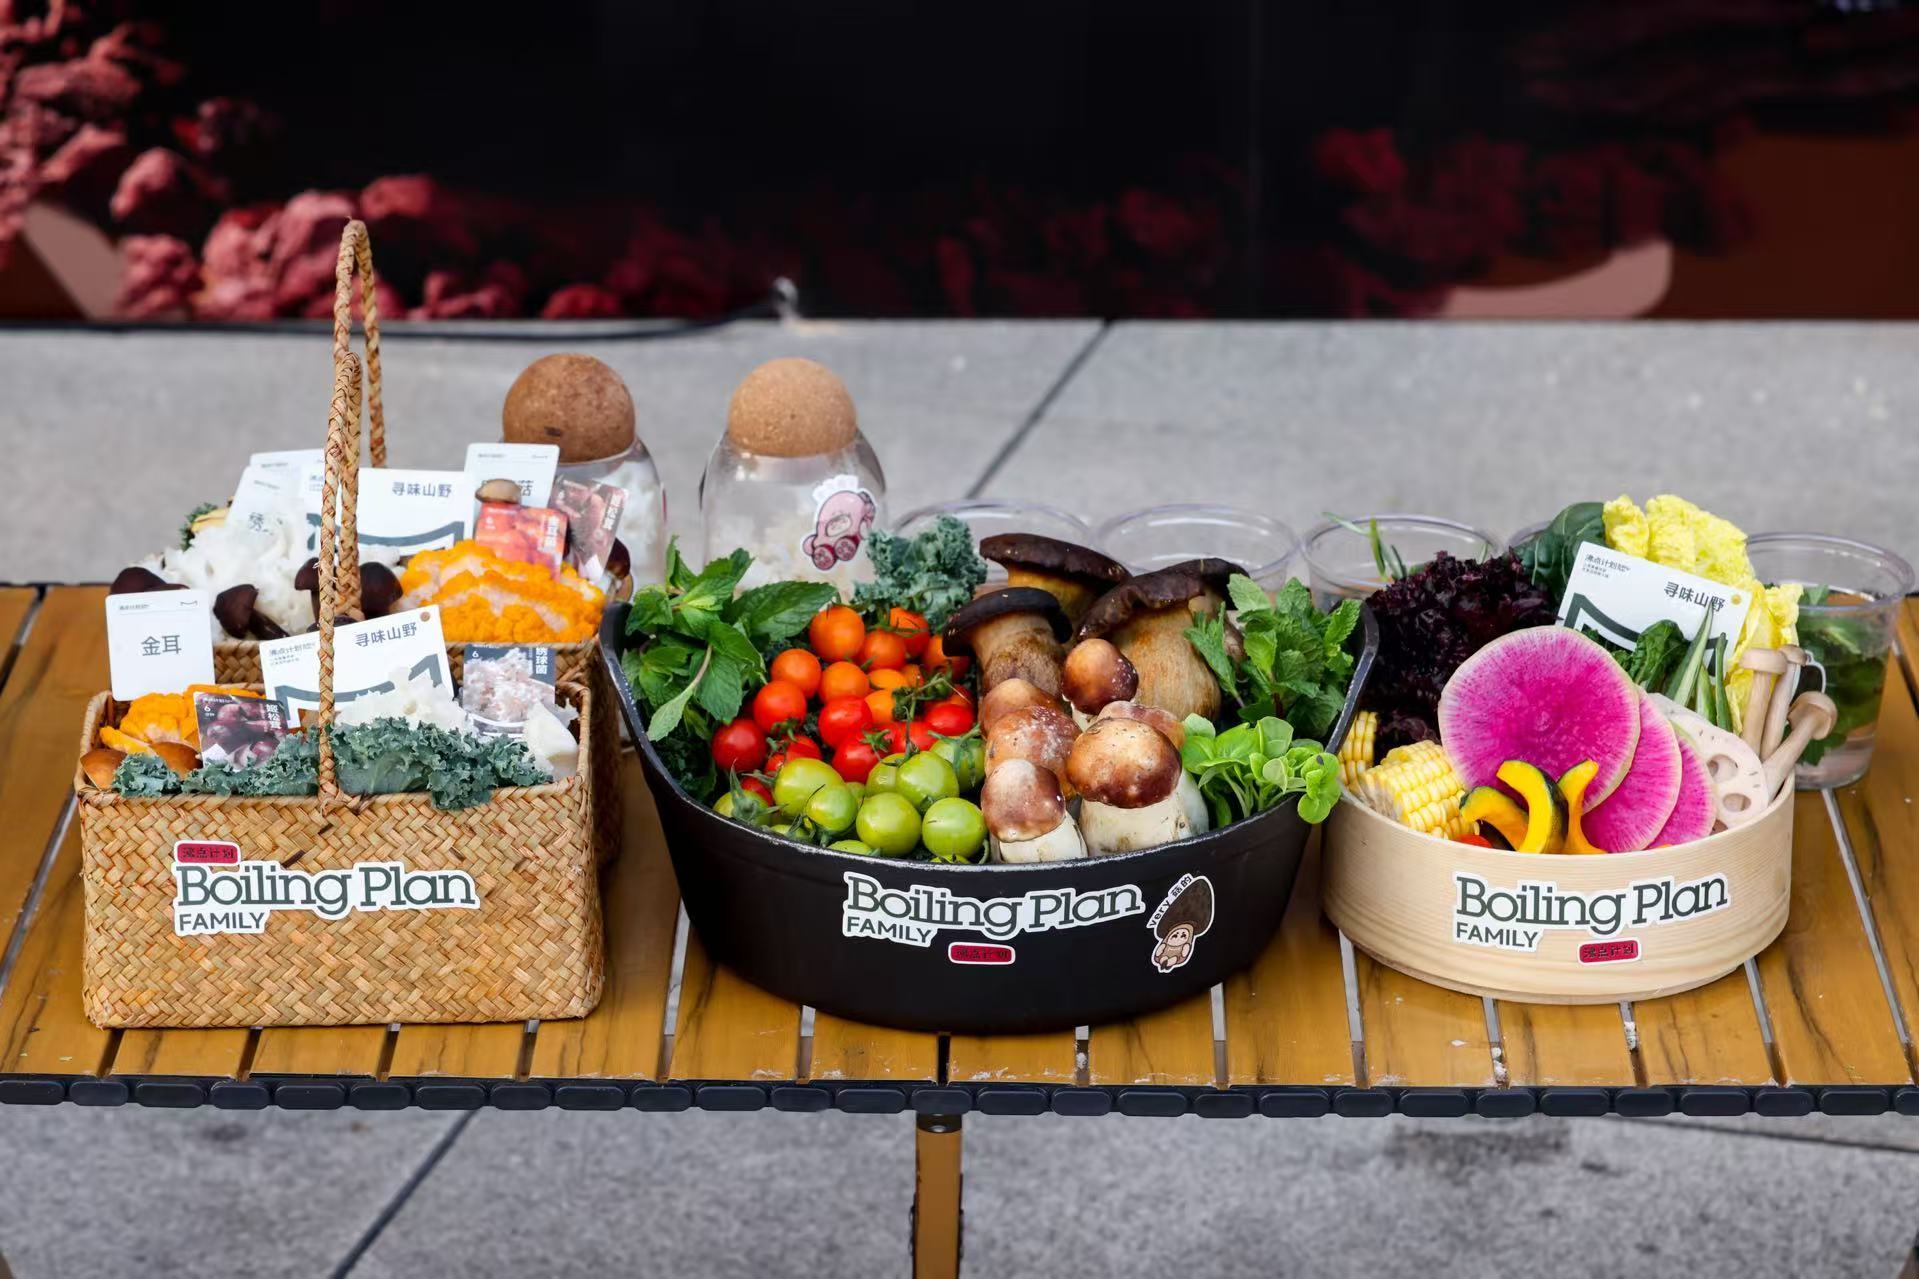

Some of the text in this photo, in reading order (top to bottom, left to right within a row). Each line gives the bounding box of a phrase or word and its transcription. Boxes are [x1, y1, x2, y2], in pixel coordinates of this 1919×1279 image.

[392, 481, 452, 498] 寻味山野
[1664, 581, 1726, 612] 寻味山野
[141, 634, 182, 656] 金耳
[354, 621, 418, 648] 寻味山野
[472, 650, 479, 658] 6
[176, 865, 476, 916] Boiling Plan
[847, 875, 1141, 937] Boiling Plan
[1149, 900, 1170, 926] very
[1456, 876, 1727, 936] Boiling Plan
[179, 912, 265, 931] FAMILY
[847, 916, 931, 943] FAMILY
[1456, 922, 1538, 947] FAMILY
